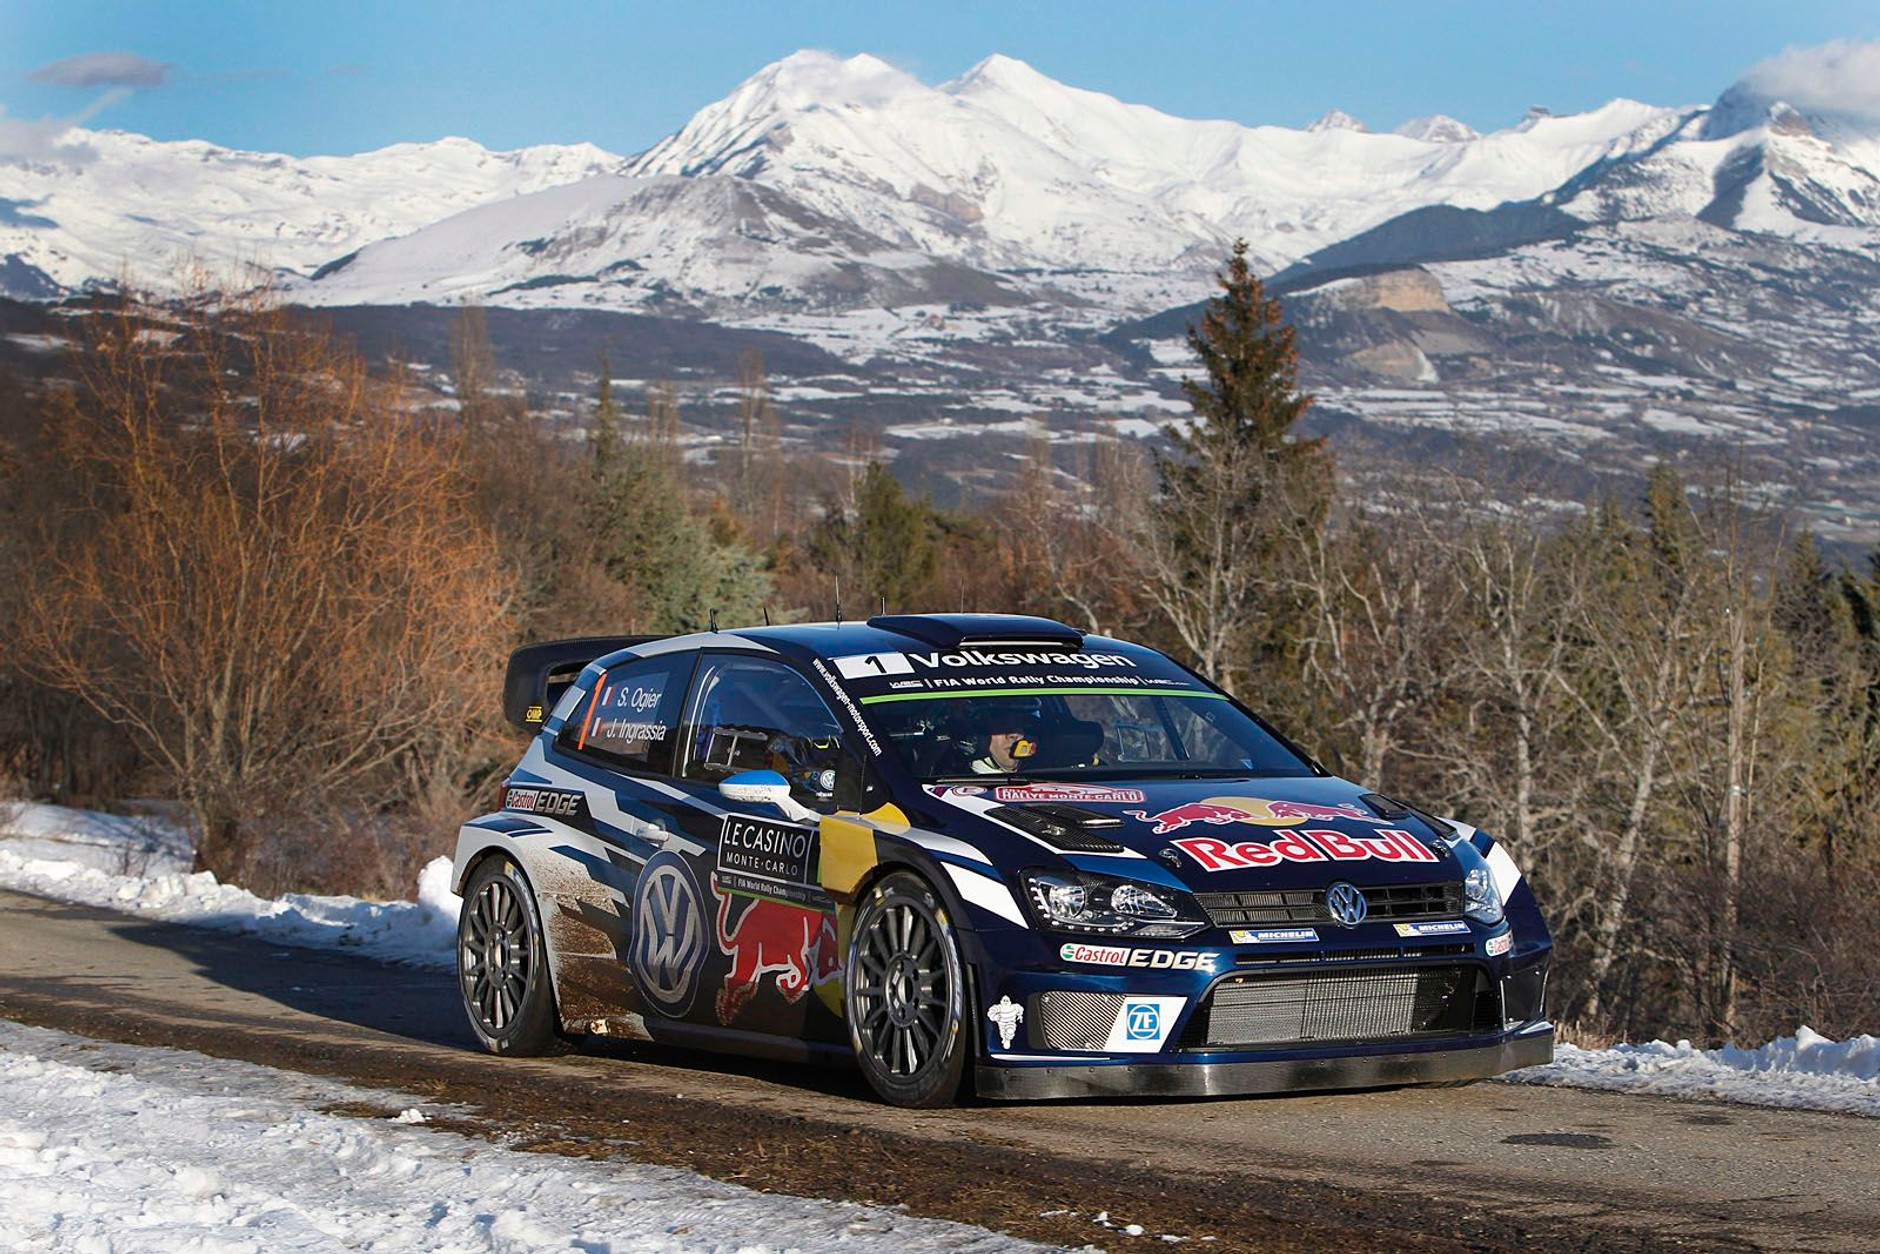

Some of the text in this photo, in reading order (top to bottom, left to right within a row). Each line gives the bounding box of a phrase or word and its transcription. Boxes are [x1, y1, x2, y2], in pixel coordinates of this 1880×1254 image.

[864, 650, 1137, 674] 1 Volkswagen
[932, 678, 962, 688] FIA
[962, 676, 1007, 687] World
[1008, 674, 1045, 685] Rally
[1046, 674, 1139, 685] Championship
[617, 686, 662, 713] S. Ogier
[812, 658, 882, 757] www.volkswagen-motorsport.com
[606, 718, 667, 744] J. Ingrassia
[511, 790, 583, 816] Castrol EDGE
[1002, 792, 1045, 800] RALLYE
[724, 821, 806, 859] LE CASINO
[1258, 930, 1314, 939] MICHELIN
[1420, 922, 1466, 931] MICHELIN
[1075, 946, 1221, 971] Castrol EDGE
[1131, 1011, 1154, 1032] ZF
